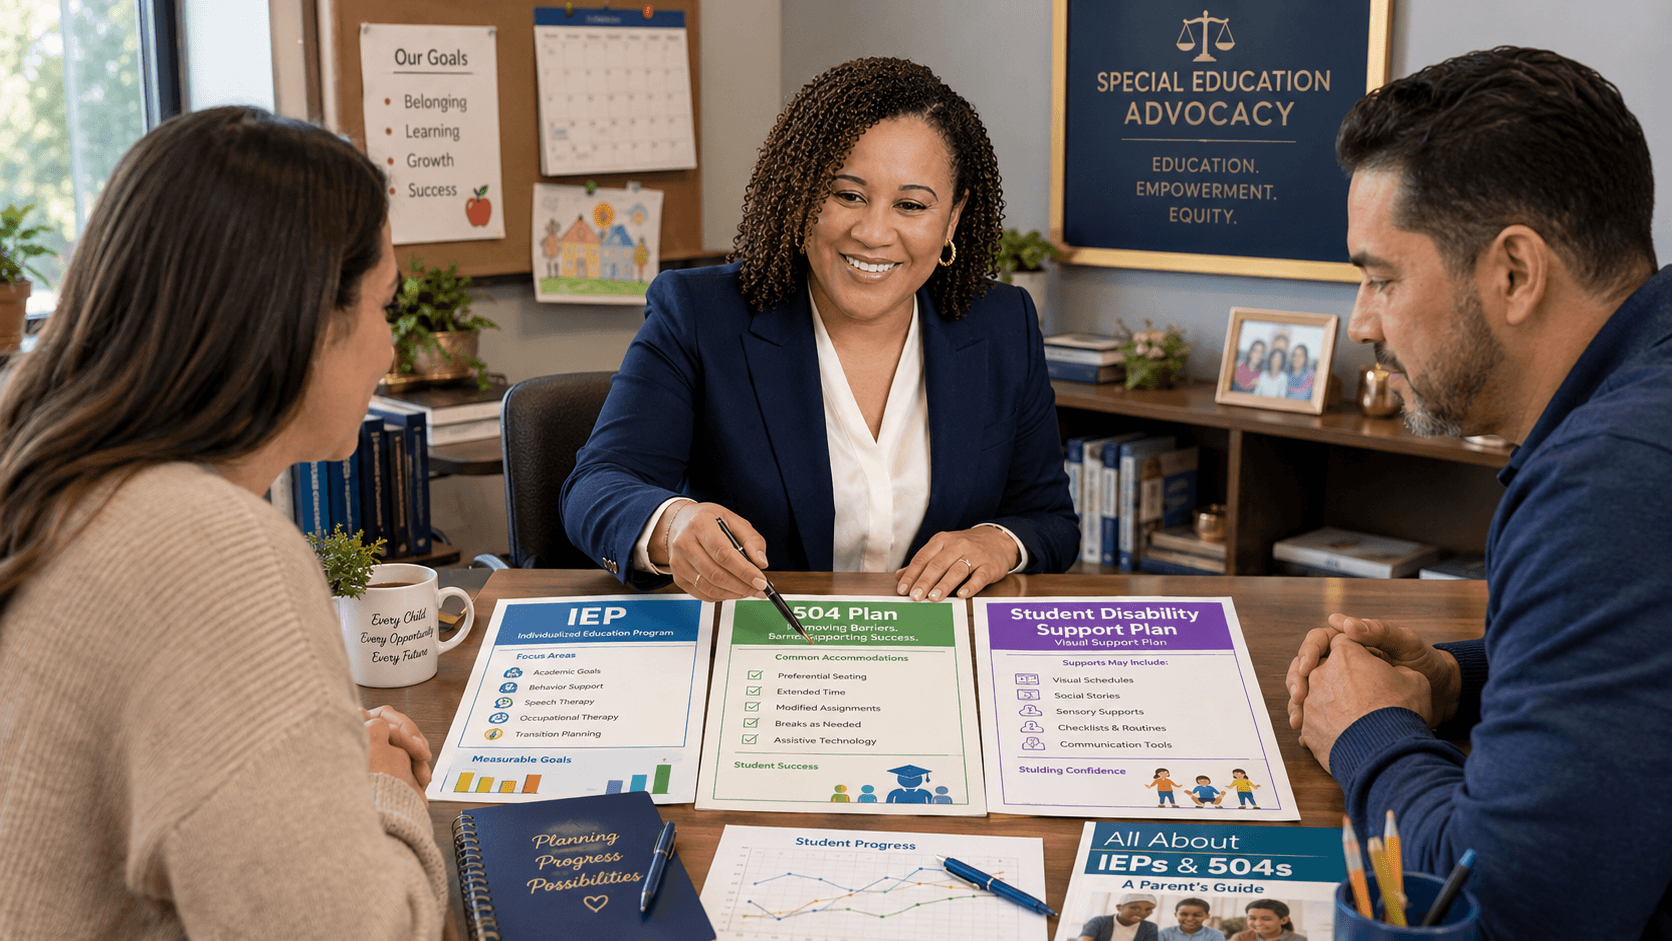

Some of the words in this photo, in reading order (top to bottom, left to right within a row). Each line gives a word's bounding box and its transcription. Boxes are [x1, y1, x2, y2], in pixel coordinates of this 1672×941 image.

[394, 48, 423, 66] Our
[427, 49, 468, 66] Goals
[1097, 71, 1184, 92] SPECIAL
[1193, 70, 1330, 91] EDUCATION
[404, 94, 467, 113] Belonging
[1124, 101, 1295, 126] ADVOCACY
[405, 124, 460, 142] Learning
[406, 153, 454, 168] Growth
[1152, 157, 1259, 174] EDUCATION.
[408, 183, 457, 198] Success
[1136, 181, 1277, 200] EMPOWERMENT.
[1169, 207, 1237, 224] EQUITY.
[404, 607, 426, 624] Child
[567, 607, 627, 626] IEP
[793, 606, 841, 620] 504
[848, 606, 898, 621] Plan
[1011, 607, 1095, 621] Student
[1100, 607, 1199, 623] Disability
[786, 623, 847, 633] moving
[850, 624, 898, 632] Barriers.
[1036, 623, 1124, 638] Support
[1130, 623, 1177, 636] Plan
[518, 631, 581, 639] Individualized
[583, 629, 630, 638] Education
[633, 629, 674, 637] Program
[870, 634, 919, 642] Success.
[1091, 638, 1139, 648] Support
[1141, 638, 1167, 646] Plan
[775, 653, 820, 661] Common
[822, 654, 909, 662] Accommodations
[1062, 659, 1106, 667] Supports
[1108, 659, 1128, 667] May
[577, 667, 601, 675] Goals
[778, 672, 830, 680] Preferential
[832, 673, 867, 682] Seating
[529, 683, 567, 692] Behavior
[568, 683, 604, 692] Support
[777, 688, 821, 696] Extended
[1054, 692, 1084, 700] Social
[1086, 692, 1121, 700] Stories
[524, 698, 558, 707] Speech
[559, 698, 595, 707] Therapy
[776, 704, 817, 712] Modified
[820, 704, 881, 714] Assignments
[1056, 708, 1096, 717] Sensory
[1098, 708, 1145, 717] Supports
[520, 714, 580, 723] Occupational
[582, 713, 619, 722] Therapy
[775, 720, 808, 728] Breaks
[823, 721, 861, 729] Needed
[1058, 724, 1109, 732] Checklists
[1122, 724, 1167, 732] Routines
[562, 730, 602, 740] Planning
[773, 736, 816, 745] Assistive
[819, 737, 877, 747] Technology
[1060, 740, 1142, 748] Communication
[1144, 741, 1172, 749] Tools
[472, 756, 537, 764] Measurable
[540, 756, 572, 764] Goals
[734, 761, 775, 770] Student
[777, 763, 819, 771] Success
[1065, 767, 1127, 775] Confidence
[531, 831, 620, 849] Planning
[795, 837, 851, 848] Student
[854, 840, 917, 851] Progress
[1104, 831, 1140, 847] All
[1148, 831, 1240, 850] About
[535, 852, 623, 870] Progress
[1098, 854, 1168, 873] IEPs
[1177, 858, 1199, 874] &
[1208, 858, 1293, 876] 504s
[526, 871, 644, 894] Possibilities
[1121, 880, 1134, 889] A
[1139, 880, 1209, 893] Parent's
[1213, 882, 1265, 894] Guide
